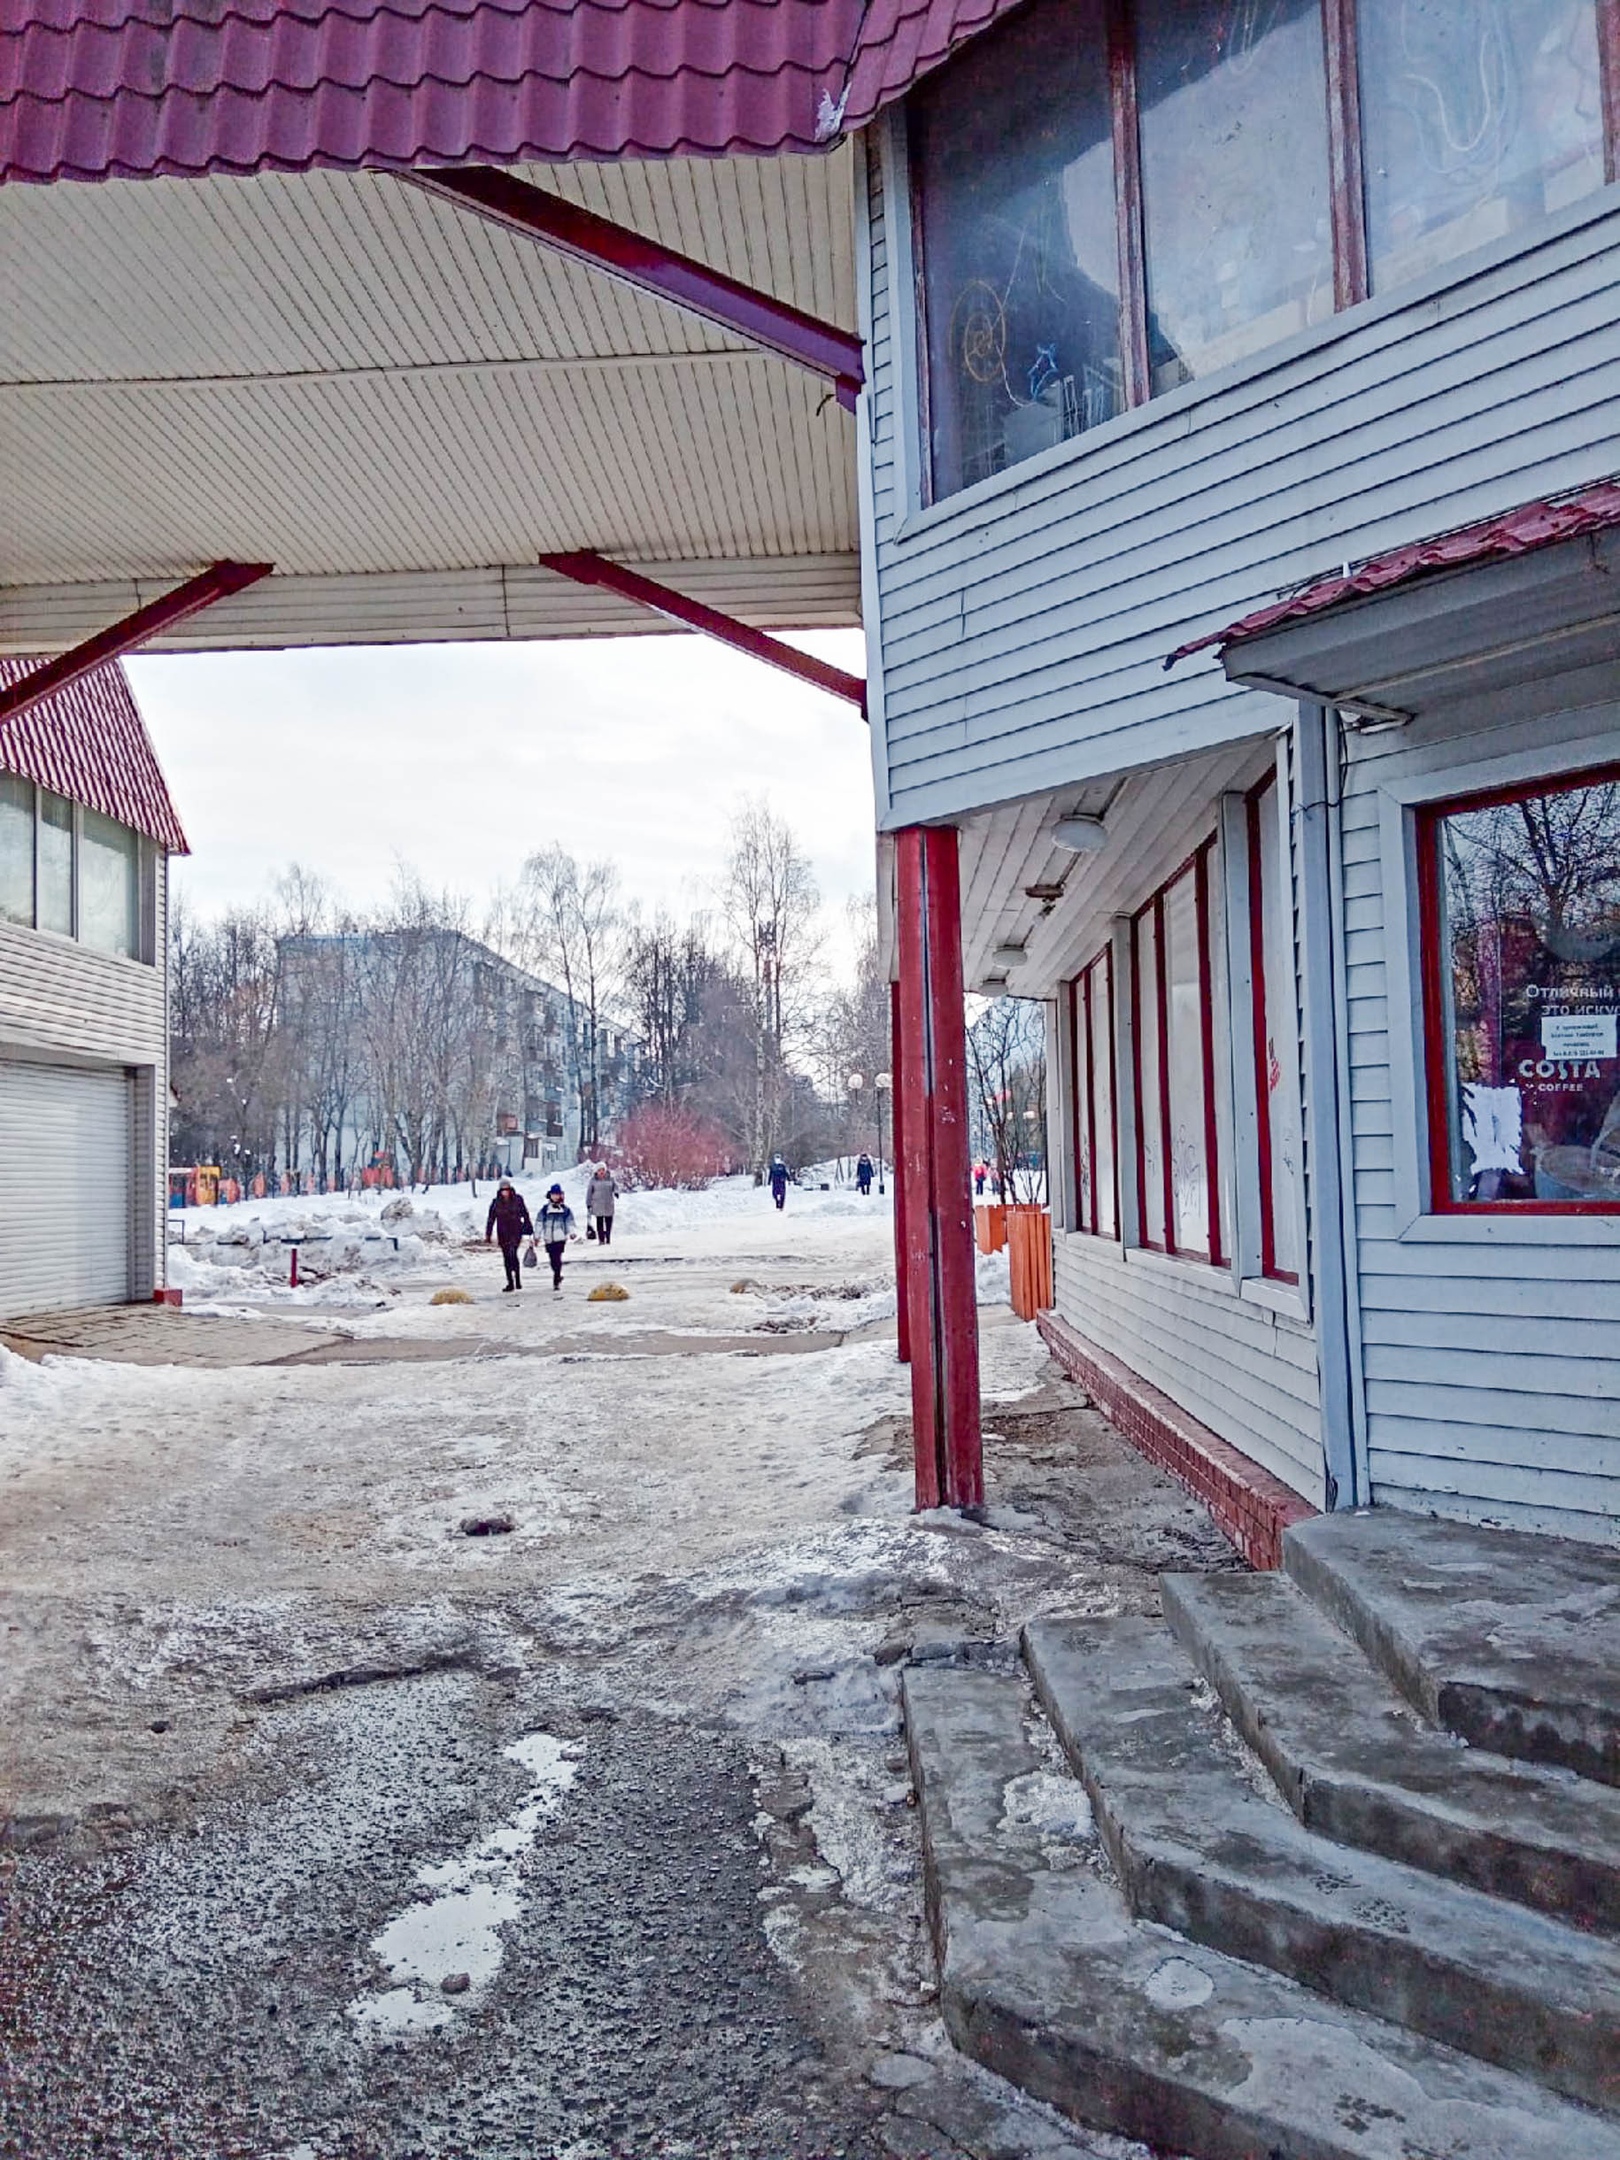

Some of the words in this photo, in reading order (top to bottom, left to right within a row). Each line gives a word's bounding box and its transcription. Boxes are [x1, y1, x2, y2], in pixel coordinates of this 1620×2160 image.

[1526, 984, 1614, 999] Отличный
[1518, 1059, 1601, 1080] COSTA
[1538, 1083, 1584, 1092] COFFEE
